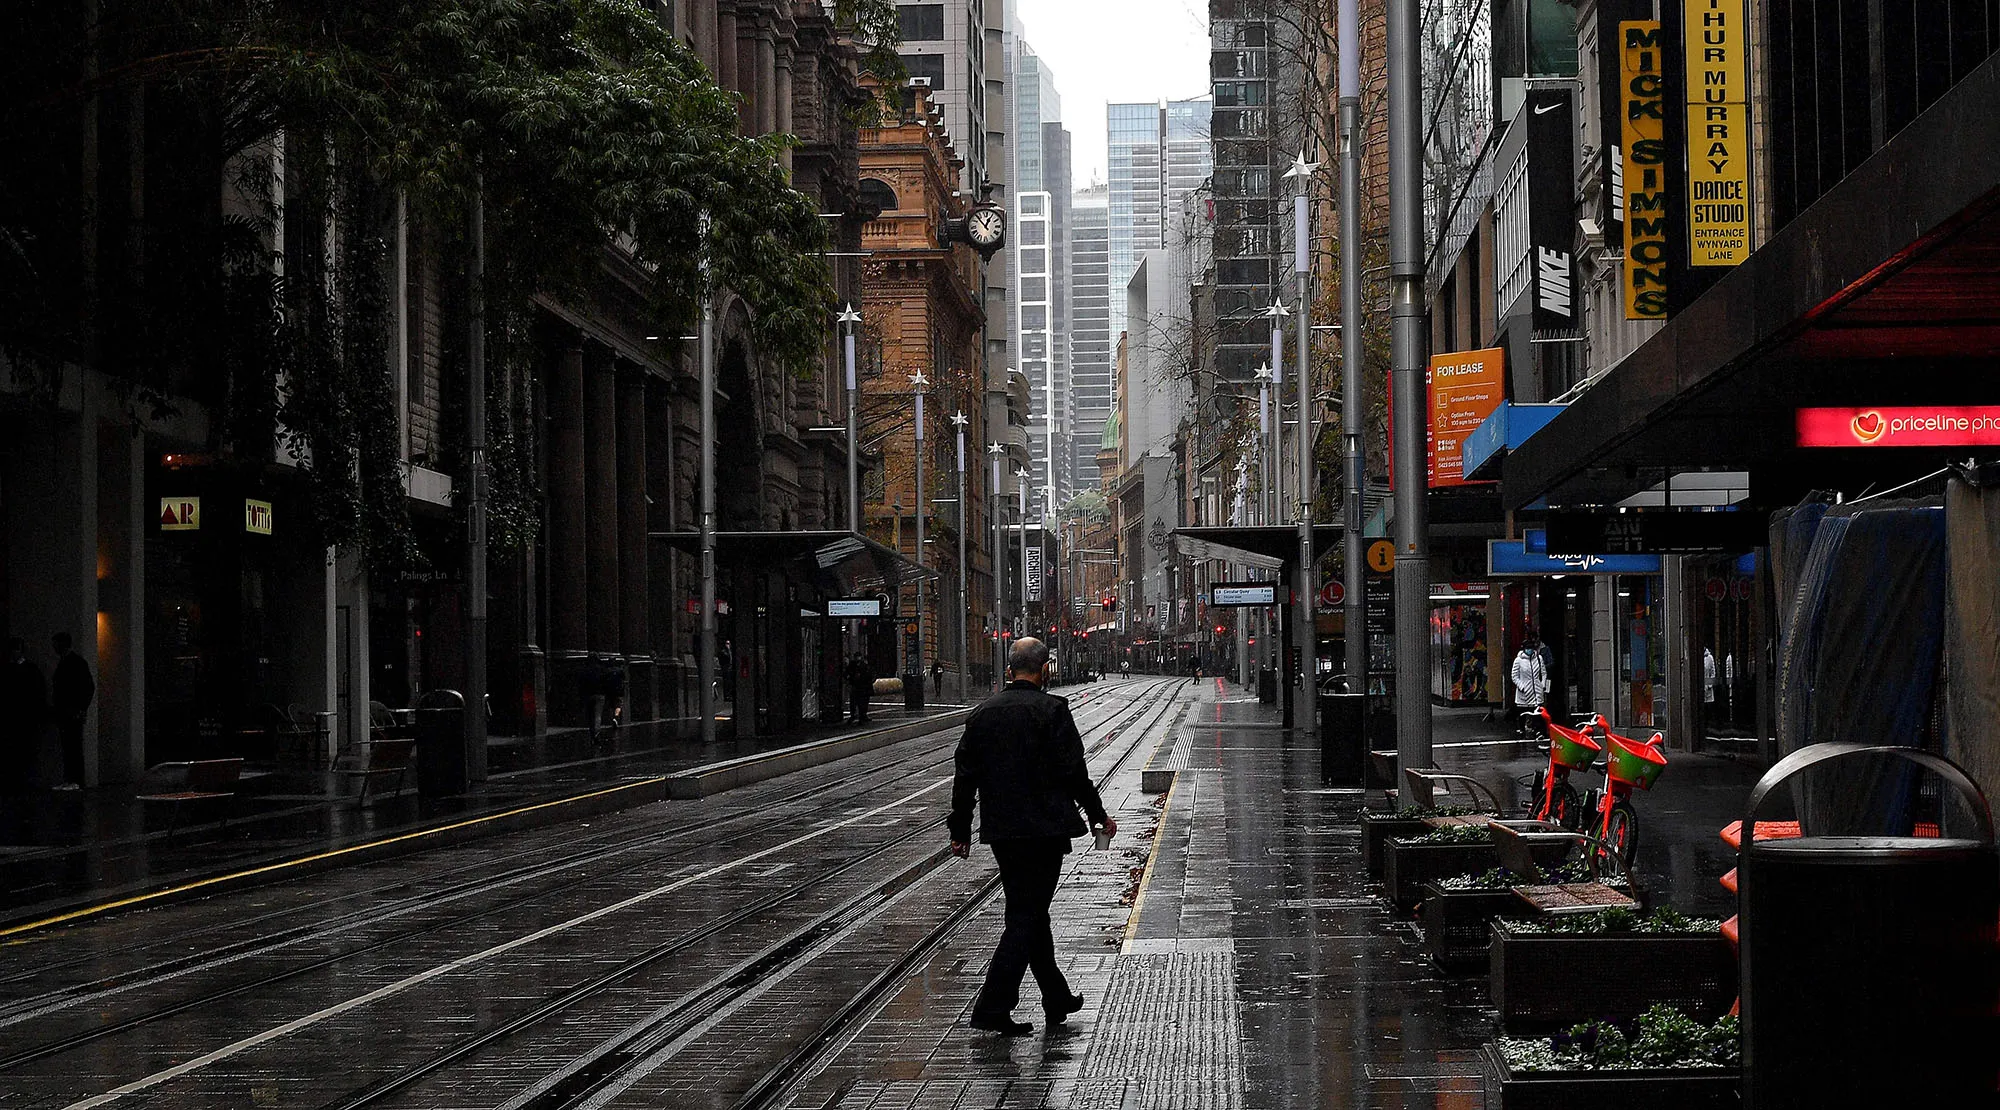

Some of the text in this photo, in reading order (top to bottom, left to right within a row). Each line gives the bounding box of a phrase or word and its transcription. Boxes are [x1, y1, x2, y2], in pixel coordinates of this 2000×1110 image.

[1704, 70, 1728, 174] MURRAY
[1626, 27, 1667, 316] MICK SIMMONS
[1693, 180, 1743, 201] DANCE
[1694, 203, 1744, 224] STUDIO
[1695, 228, 1744, 238] ENTRANCE
[1697, 240, 1743, 251] WYNYARD
[1708, 252, 1733, 260] LANE
[1538, 245, 1571, 317] NIKE
[1436, 362, 1484, 377] FOR LEASE
[1890, 414, 1969, 435] priceline
[435, 569, 447, 580] Ln
